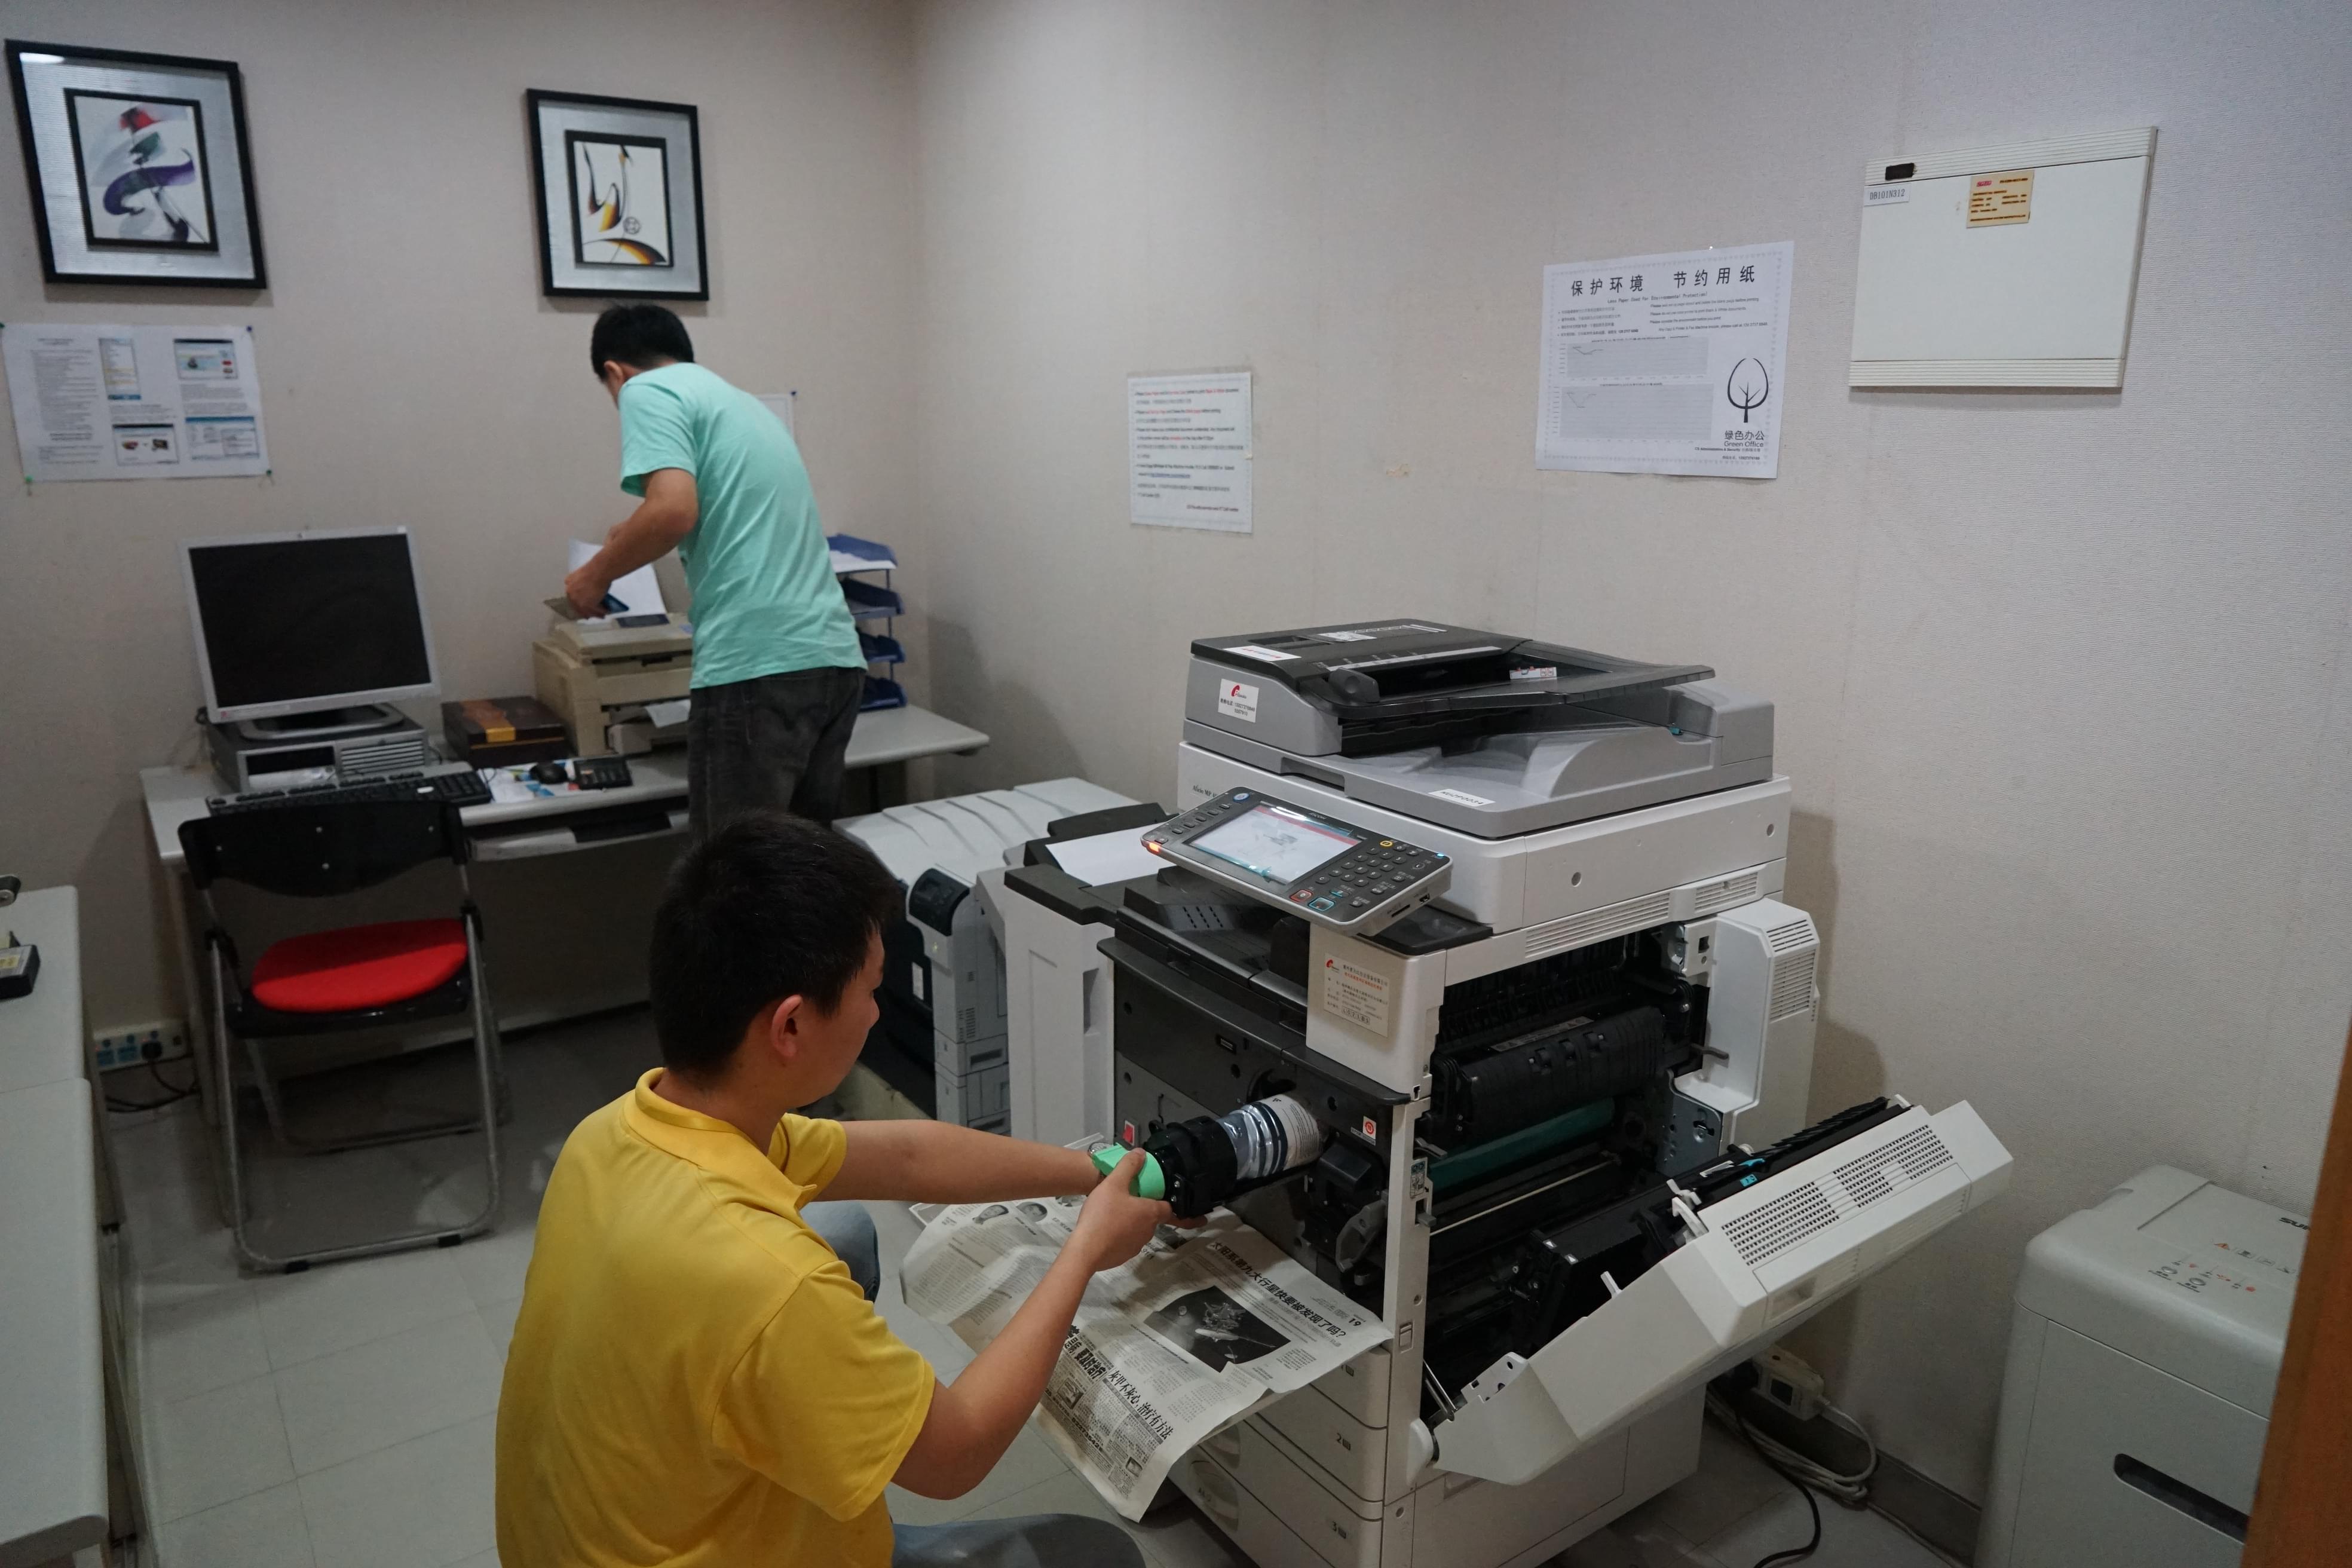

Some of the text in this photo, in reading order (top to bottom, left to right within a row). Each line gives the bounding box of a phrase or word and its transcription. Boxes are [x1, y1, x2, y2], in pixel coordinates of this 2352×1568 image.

[1870, 188, 1905, 200] DB101N312
[1570, 265, 1755, 297] 保护环境 节约用纸
[1725, 430, 1765, 440] 绿色办公
[1349, 1318, 1361, 1327] 19
[1336, 1432, 1342, 1444] 2
[1332, 1520, 1337, 1532] 3
